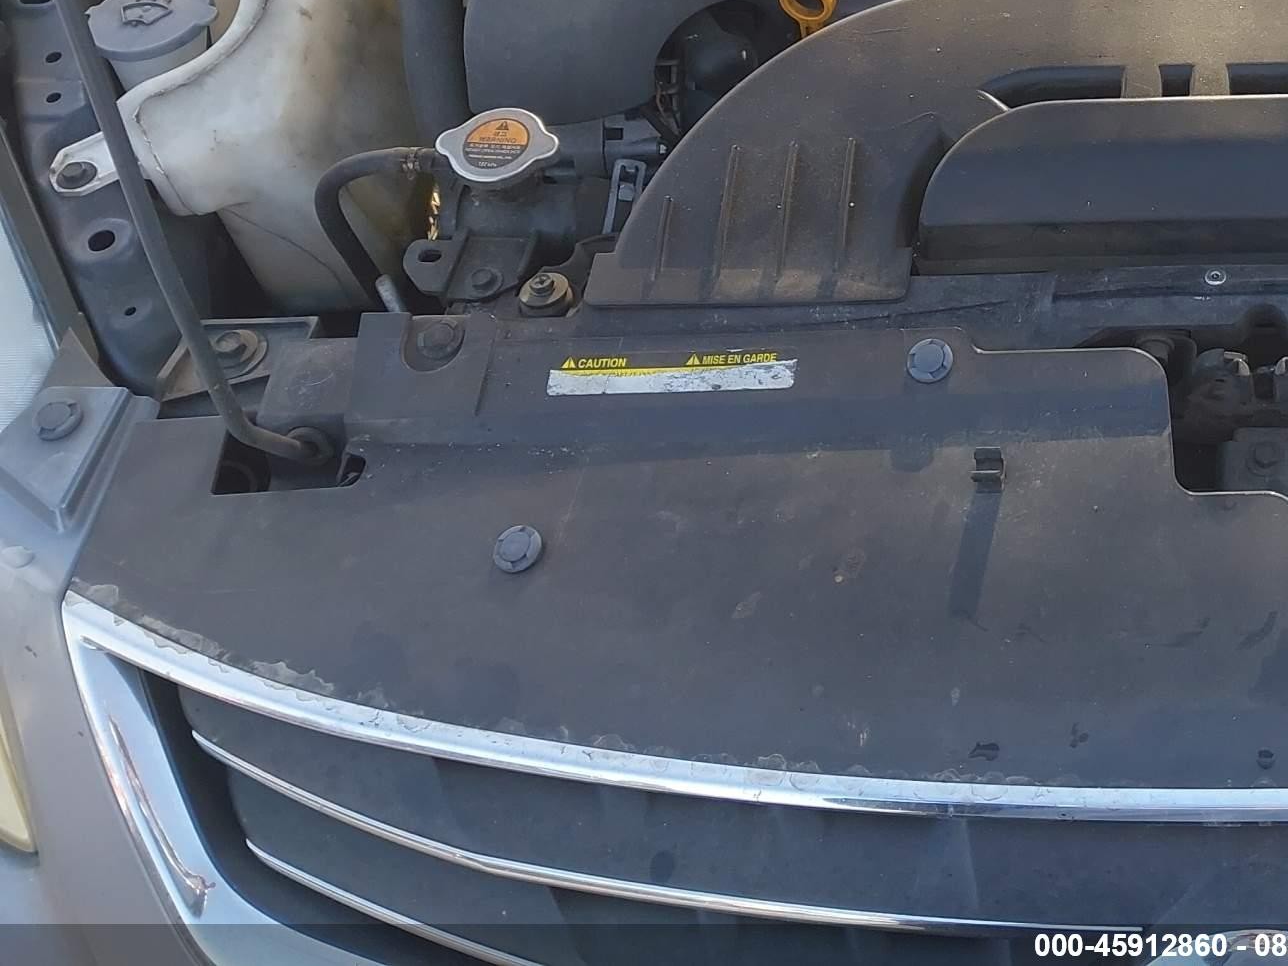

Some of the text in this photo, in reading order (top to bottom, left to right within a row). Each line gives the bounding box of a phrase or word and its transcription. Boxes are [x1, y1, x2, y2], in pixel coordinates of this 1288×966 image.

[577, 357, 627, 369] CAUTION
[702, 352, 777, 365] MISE EN GARDE
